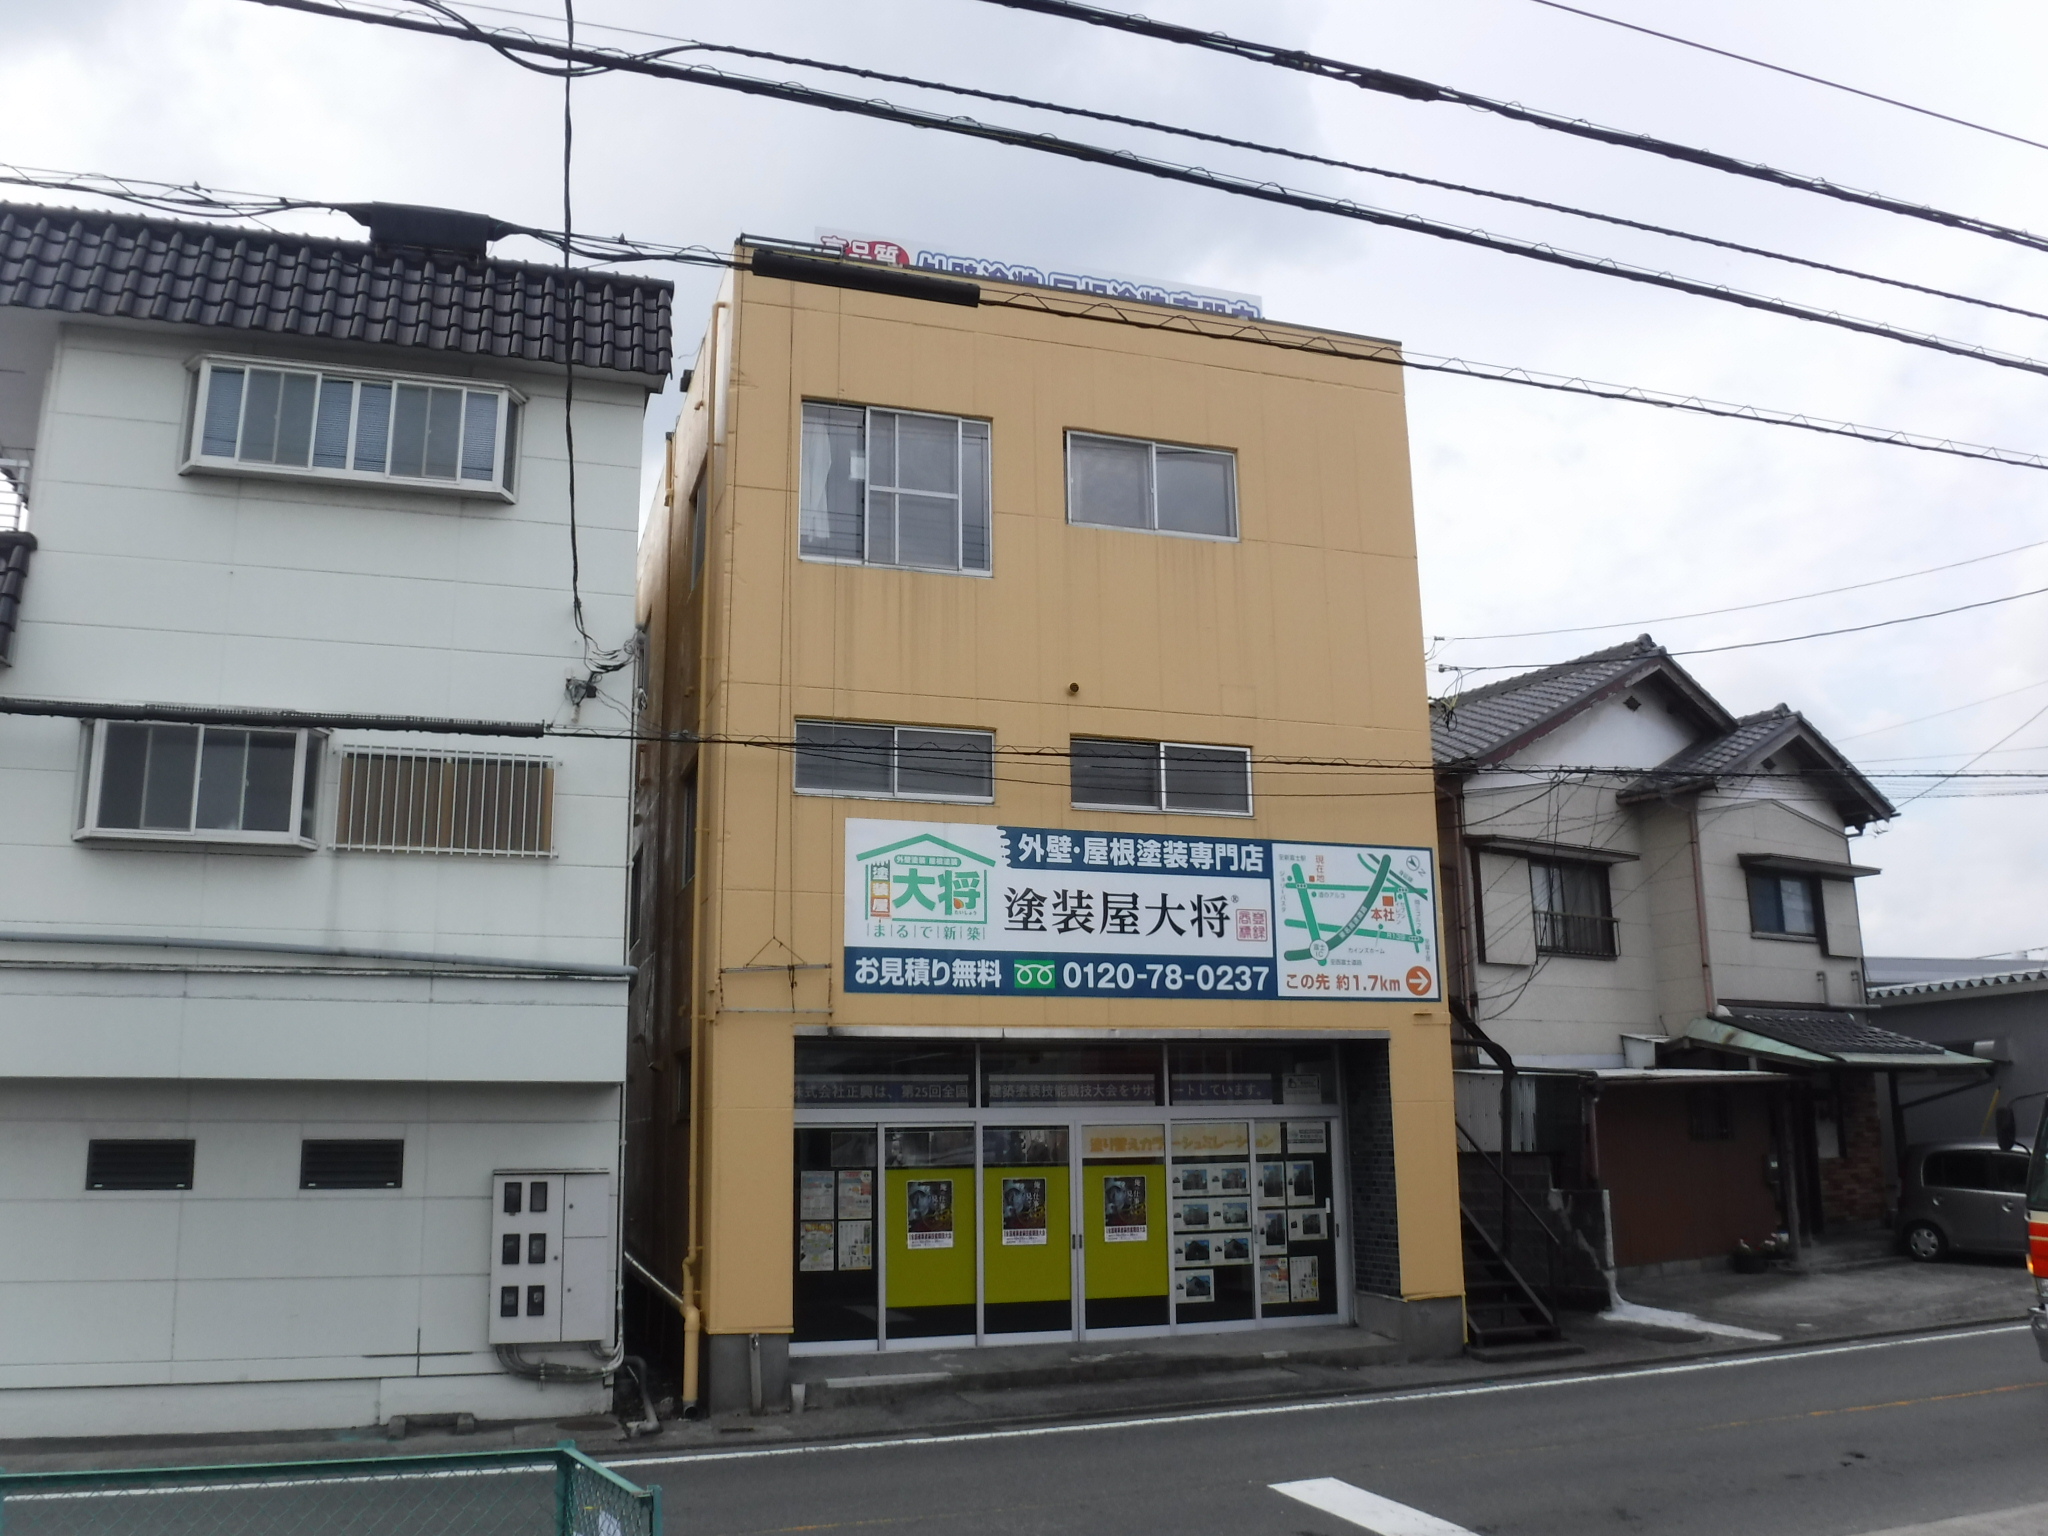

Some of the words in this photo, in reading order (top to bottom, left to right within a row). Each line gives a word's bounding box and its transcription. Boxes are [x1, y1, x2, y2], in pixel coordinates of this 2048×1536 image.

[1018, 833, 1264, 872] 外壁・屋根塗装専門店
[1315, 855, 1325, 882] 現在地
[892, 868, 980, 916] 大将
[1004, 886, 1231, 938] 塗装屋大将
[1371, 908, 1395, 922] 本社
[874, 924, 980, 941] まるで新築
[855, 957, 1002, 988] お見積り無料
[1063, 961, 1269, 991] 0120-78-0237
[1286, 973, 1330, 990] この先
[1336, 974, 1401, 991] 約1.7km
